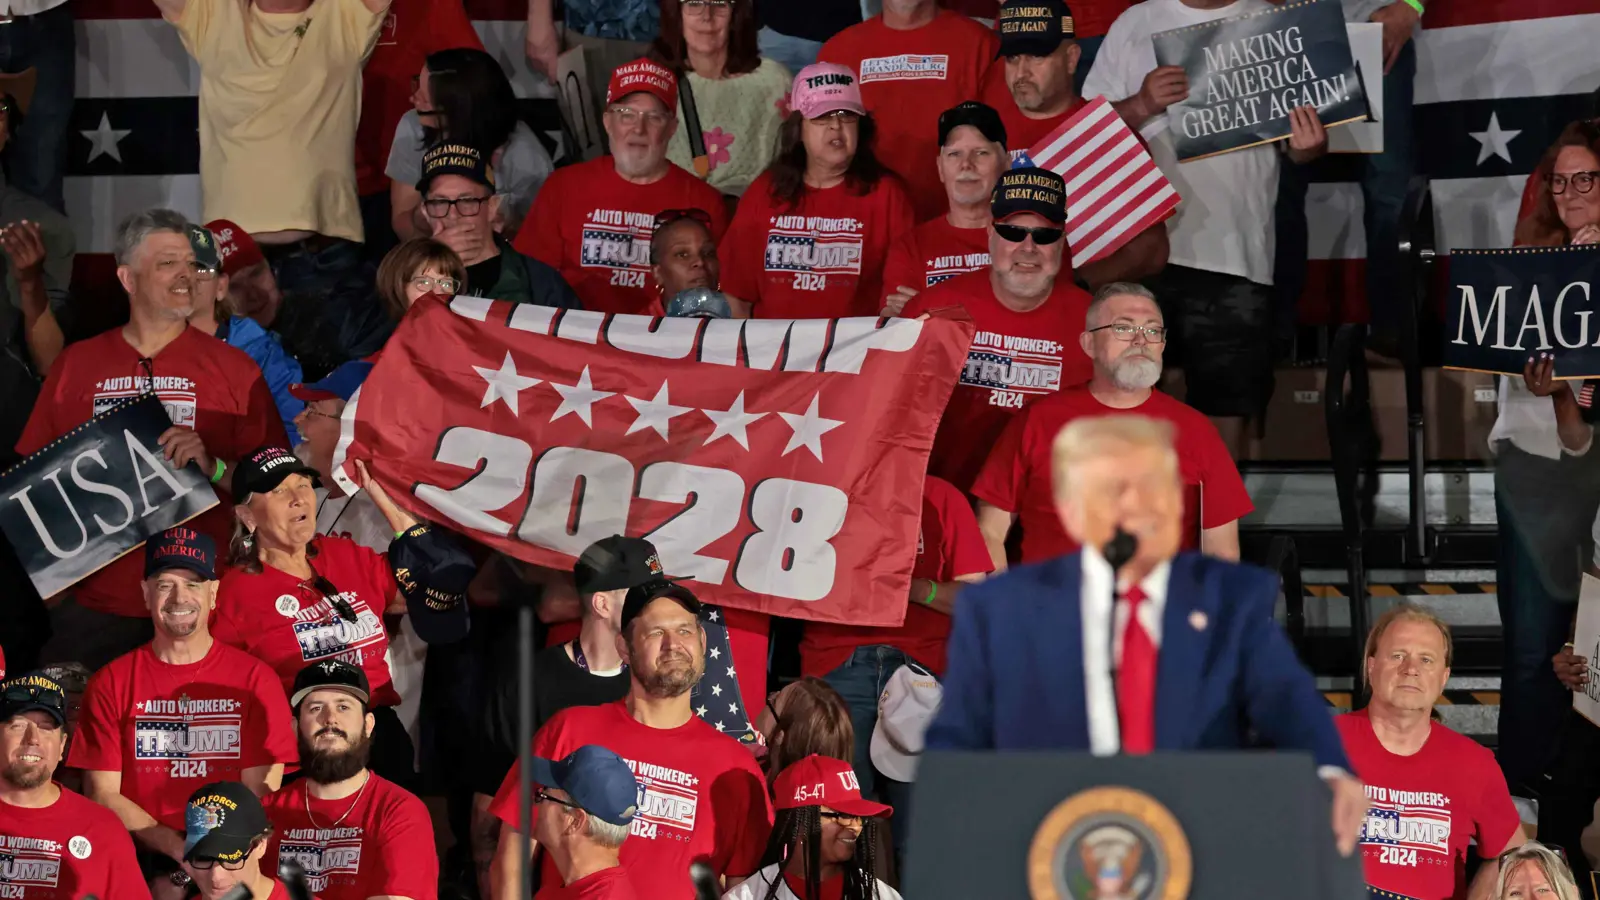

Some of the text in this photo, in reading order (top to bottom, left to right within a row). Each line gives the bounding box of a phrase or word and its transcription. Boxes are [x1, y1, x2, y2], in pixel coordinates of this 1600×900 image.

[1014, 7, 1053, 18] AMERICA
[1020, 21, 1048, 32] AGAIN
[1203, 26, 1304, 73] MAKING
[616, 64, 639, 78] MAKE
[1206, 54, 1318, 105] AMERICA
[805, 73, 854, 89] TRUMP
[1182, 73, 1350, 139] GREAT AGAIN!
[442, 144, 480, 160] AMERICA
[1003, 174, 1063, 193] MAKE AMERICA
[1005, 188, 1032, 200] GREAT
[1033, 190, 1058, 205] AGAIN
[592, 209, 623, 225] AUTO
[776, 216, 857, 232] AUTO WORKERS
[583, 238, 651, 266] TRUM
[767, 243, 859, 268] TRUMP
[934, 255, 963, 269] AUTO
[610, 270, 646, 289] 2024
[793, 273, 827, 291] 2024
[1451, 281, 1600, 350] MAG
[973, 331, 1057, 355] AUTO WORKERS
[966, 359, 1060, 388] TRUMP
[103, 376, 132, 391] AUTO
[989, 390, 1024, 409] 2024
[260, 456, 297, 473] TRUMP
[8, 428, 193, 559] USA
[411, 427, 848, 602] 2028
[165, 527, 198, 541] GULF
[153, 545, 206, 564] AMERICA
[297, 613, 379, 654] TRUMP
[1, 676, 27, 692] MAKE
[27, 675, 65, 698] AMERICA
[144, 699, 235, 715] AUTO WORKERS
[138, 729, 240, 753] TRUMP
[170, 760, 207, 778] 2024
[638, 761, 692, 787] WORKERS
[837, 770, 861, 791] US
[794, 783, 825, 802] 45-47
[1364, 785, 1444, 808] UTO WORKERS
[192, 795, 239, 811] AIR FORCE
[636, 788, 693, 821] UMP
[289, 827, 358, 841] AUTO WORKERS
[630, 819, 658, 840] 024
[1363, 816, 1449, 845] RUMP
[7, 835, 57, 852] WORKERS
[1380, 846, 1418, 868] 2024
[0, 861, 58, 880] UMP
